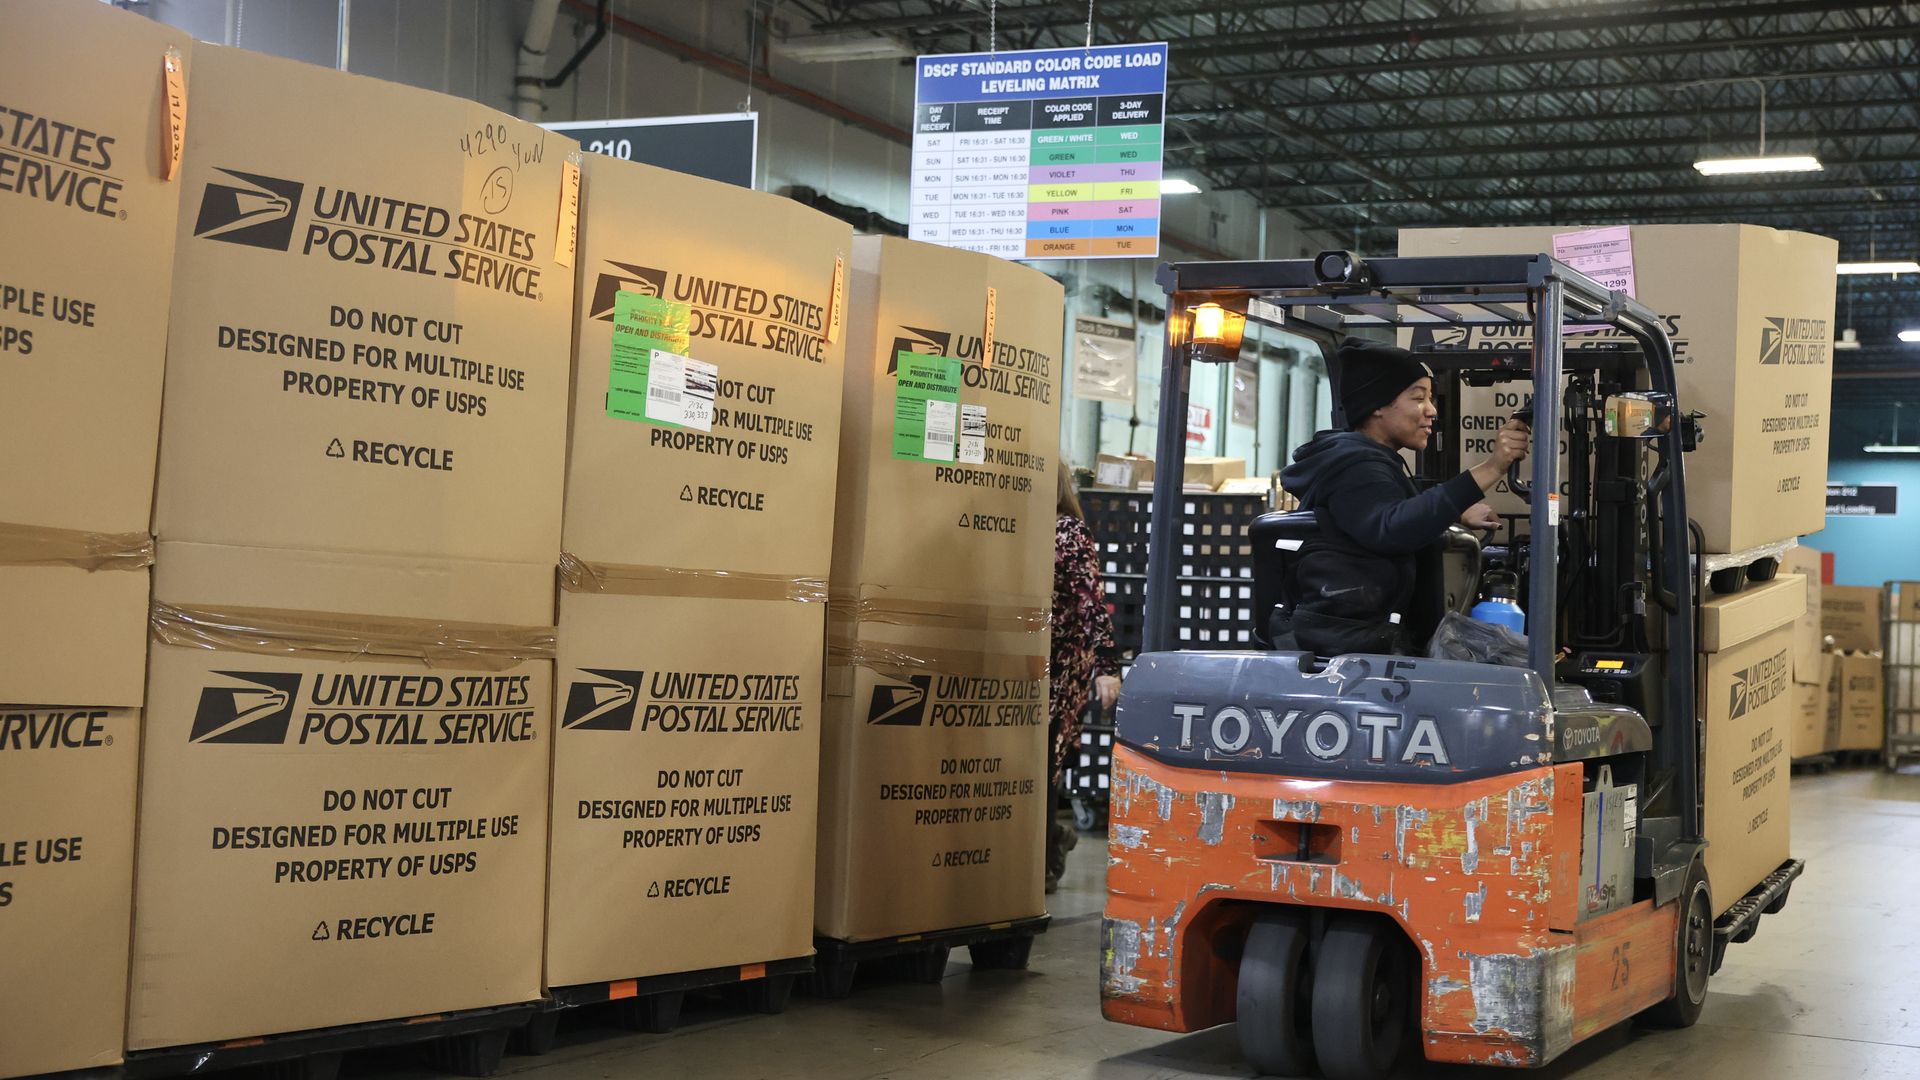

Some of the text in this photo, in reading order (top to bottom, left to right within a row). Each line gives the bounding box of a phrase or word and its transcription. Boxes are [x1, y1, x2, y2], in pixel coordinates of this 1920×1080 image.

[924, 53, 1161, 77] DSCF STANDARD COLOR CODE LOAD
[981, 75, 1099, 94] LEVELING MATRIX
[978, 107, 1009, 115] RECEIPT
[1053, 113, 1083, 121] APPLIED
[1112, 111, 1149, 119] DELIVERY
[1120, 101, 1142, 109] 3-DAY
[921, 123, 950, 131] RECEIPT
[1038, 134, 1093, 143] GREEN WHITE
[313, 187, 535, 263] UNITED STATES
[303, 223, 539, 301] POSTAL SERVICE
[53, 296, 95, 327] USE
[674, 274, 823, 331] UNITED STATES
[331, 306, 463, 344] DO NOT CUT
[616, 324, 648, 336] OPEN AND
[689, 310, 824, 363] OSTAL SERVICE
[219, 326, 524, 391] DESIGNED FOR MULTIPLE USE
[1018, 349, 1049, 377] STATES
[898, 379, 912, 387] OPEN
[927, 383, 957, 394] DISTRIBUTE
[910, 370, 932, 378] PRIORITY
[283, 370, 486, 416] PROPERTY OF USPS
[1014, 378, 1051, 404] SERVICE
[734, 411, 793, 437] MULTIPLE
[651, 429, 734, 456] PROPERTY
[353, 440, 453, 471] RECYCLE
[936, 467, 996, 488] PROPERTY
[698, 487, 764, 511] RECYCLE
[973, 515, 1016, 533] RECYCLE
[312, 674, 530, 707] UNITED STATES
[651, 672, 799, 700] UNITED STATES
[937, 676, 1000, 699] UNITED
[1337, 660, 1417, 701] 25
[299, 711, 534, 745] POSTAL SERVICE
[641, 705, 801, 732] POSTAL SERVICE
[930, 704, 1041, 727] POSTAL SERVICE
[1172, 703, 1450, 766] TOYOTA
[1573, 727, 1600, 745] TOYOTA
[658, 769, 743, 788] DO NOT CUT
[324, 788, 452, 811] DO NOT CUT
[880, 784, 946, 800] DESIGNED
[578, 795, 791, 819] DESIGNED FOR MULTIPLE USE
[213, 815, 518, 849] DESIGNED FOR MULTIPLE USE
[623, 825, 760, 848] PROPERTY OF USPS
[36, 837, 82, 864] USE
[944, 848, 991, 867] RECYCLE
[275, 852, 476, 883] PROPERTY OF USPS
[664, 876, 730, 898] RECYCLE
[337, 913, 435, 940] RECYCLE
[1610, 941, 1631, 991] 25
